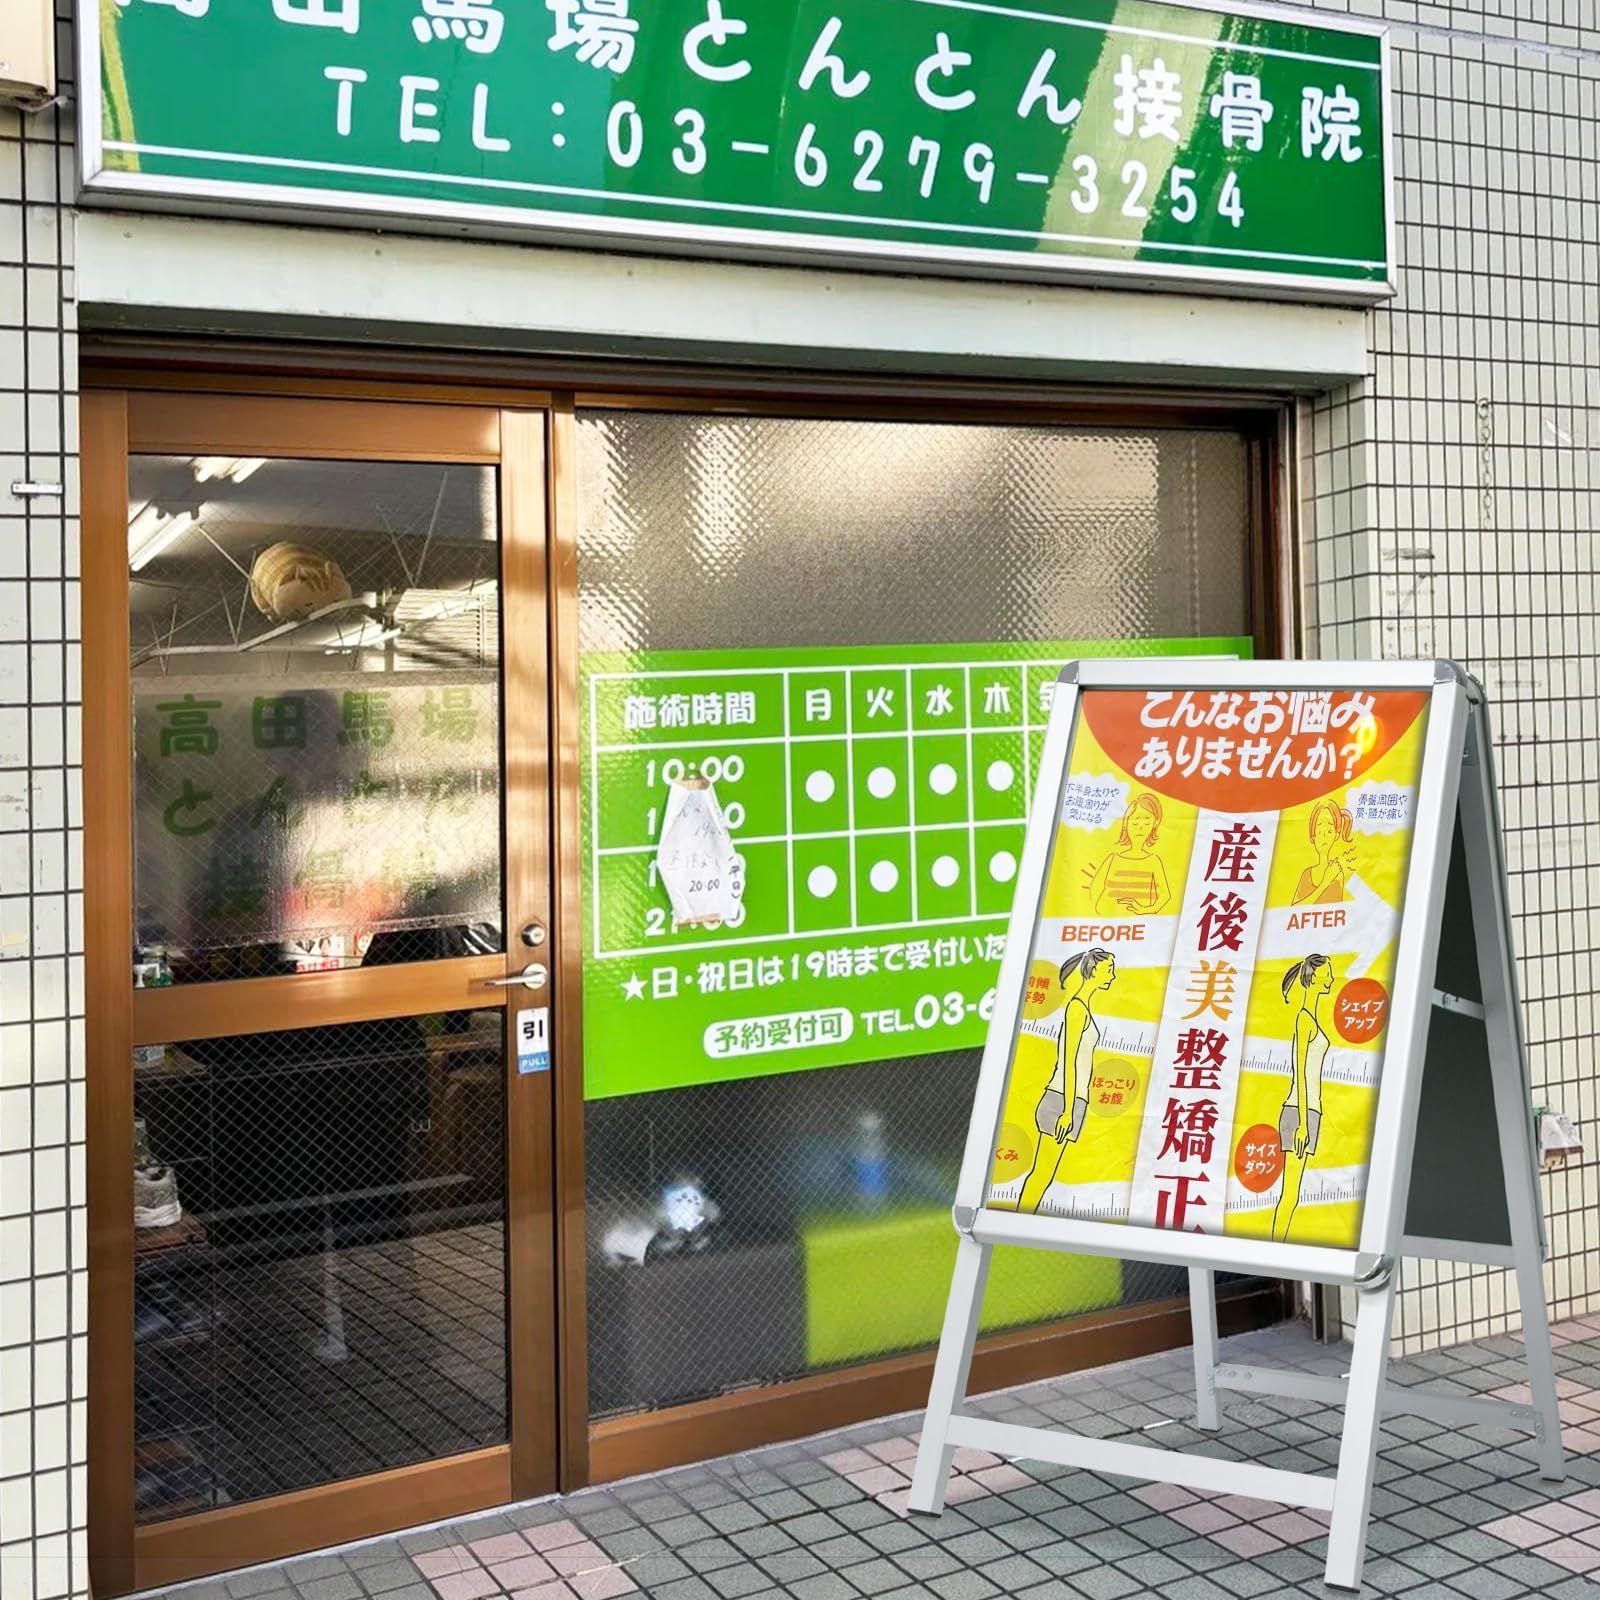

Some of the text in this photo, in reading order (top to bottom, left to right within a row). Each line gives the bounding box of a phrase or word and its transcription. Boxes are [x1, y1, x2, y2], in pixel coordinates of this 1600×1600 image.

[116, 0, 1362, 163] 馬場とんとん接骨院
[623, 690, 756, 728] 施術時間
[803, 687, 832, 722] 月
[866, 685, 895, 718] 火
[925, 685, 954, 716] 水
[984, 682, 1012, 714] 木
[155, 688, 480, 757] 高田馬場
[646, 755, 745, 788] 10:00
[1061, 925, 1146, 943] BEFORE
[1286, 909, 1346, 931] AFTER
[523, 1019, 543, 1039] 引
[713, 1011, 844, 1053] 予約受付可
[1153, 822, 1262, 1235] 産後美整矯正
[521, 1056, 547, 1067] PULL
[1098, 1091, 1124, 1105] お腹
[1245, 1143, 1278, 1158] サイズ
[1245, 1160, 1276, 1175] ダウン
